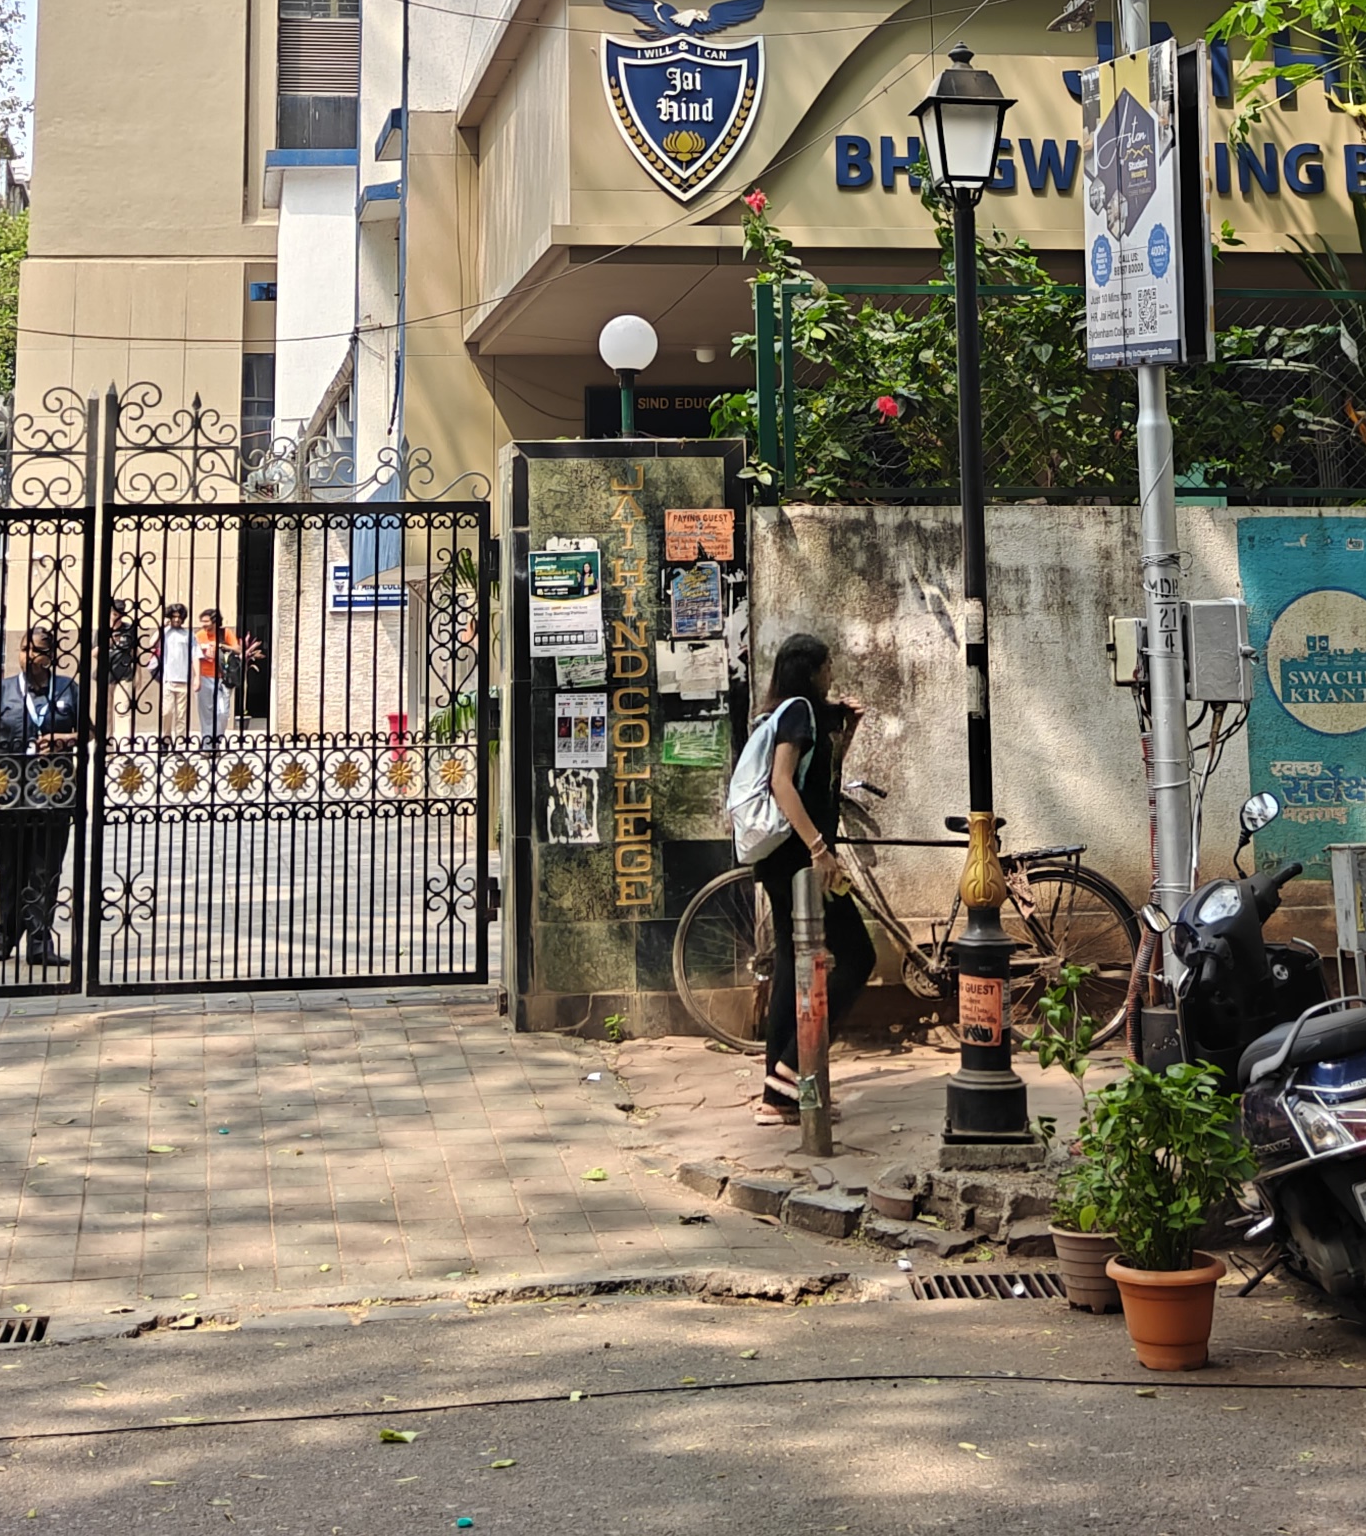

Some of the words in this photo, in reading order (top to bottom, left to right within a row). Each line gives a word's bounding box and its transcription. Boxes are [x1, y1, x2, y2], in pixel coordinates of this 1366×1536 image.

[644, 44, 673, 59] WILL
[677, 41, 689, 51] &
[704, 49, 727, 60] CAN
[663, 67, 702, 97] Jai
[656, 97, 714, 123] Hind
[637, 397, 670, 410] SIND
[610, 465, 646, 550] JAI
[673, 514, 701, 522] PAYING
[702, 514, 728, 522] GUEST
[610, 558, 649, 679] HIND
[612, 685, 653, 907] COLLEGE
[965, 983, 995, 996] GUEST
